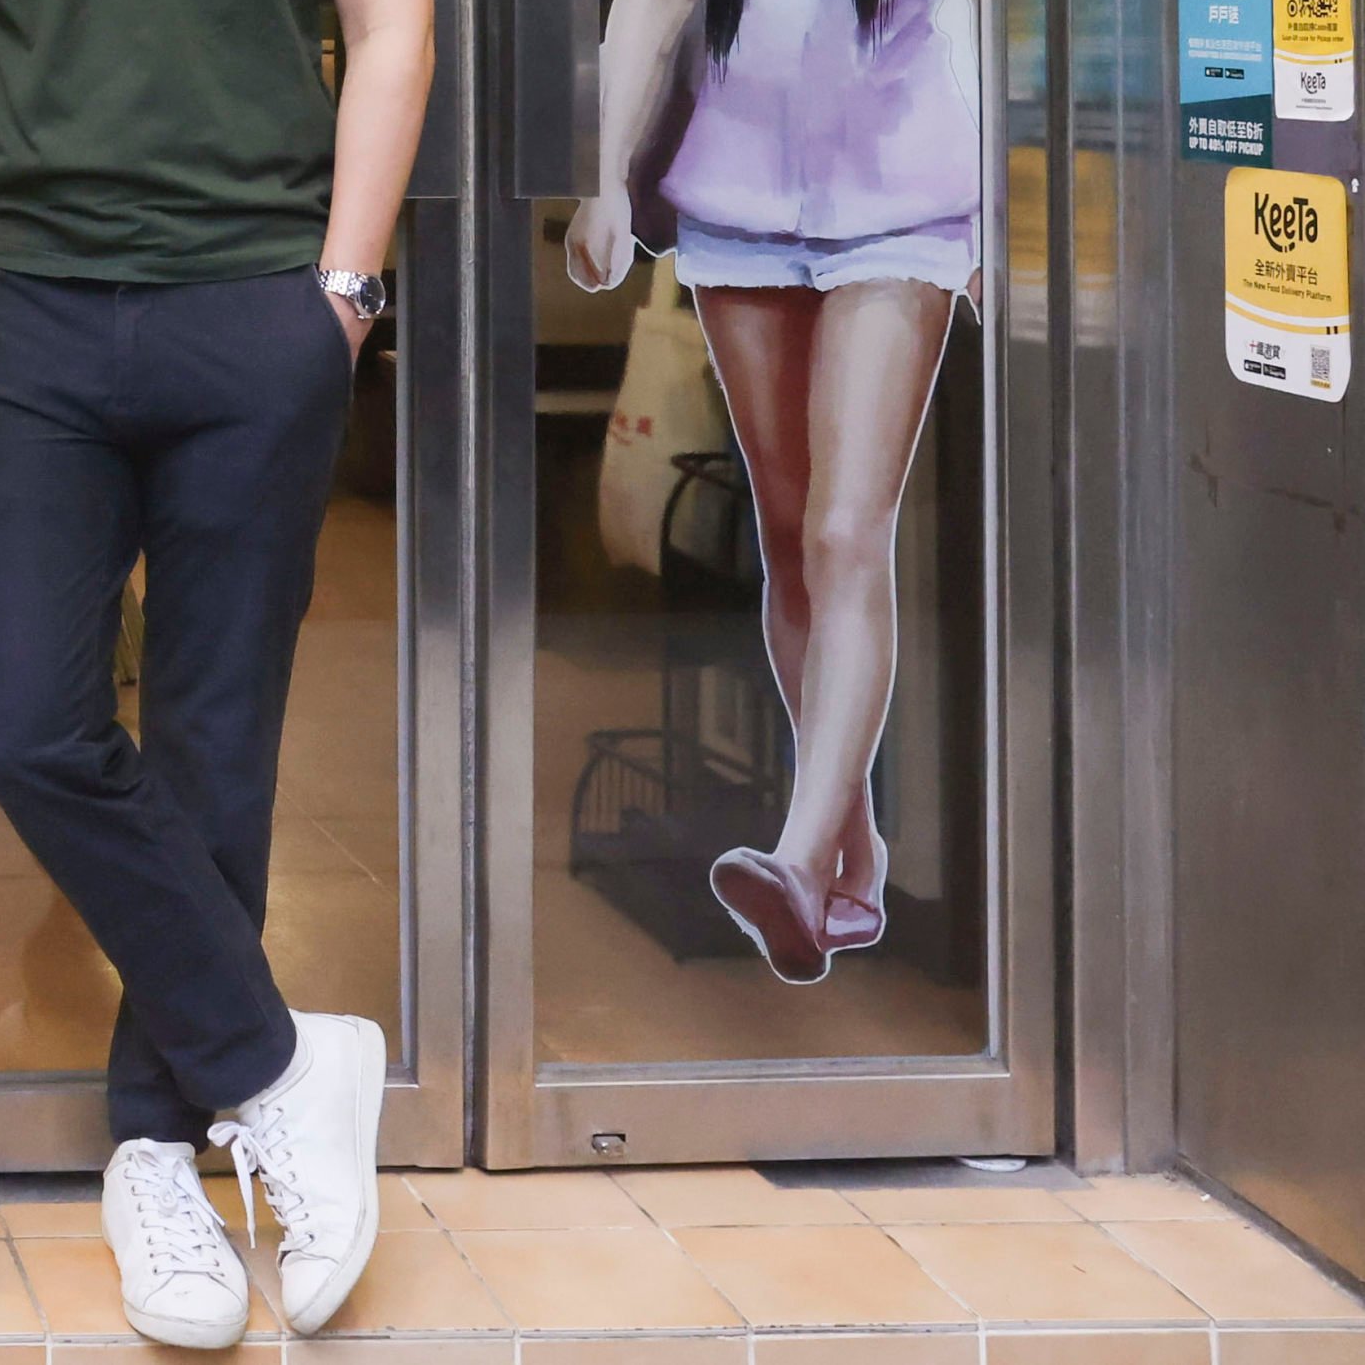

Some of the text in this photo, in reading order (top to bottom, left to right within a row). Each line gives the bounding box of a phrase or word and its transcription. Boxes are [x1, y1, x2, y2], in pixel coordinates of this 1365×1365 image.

[1238, 141, 1264, 156] PICKUP
[1254, 257, 1318, 286] 全新外賣平台
[1267, 282, 1281, 292] Food
[1306, 289, 1332, 302] Platform
